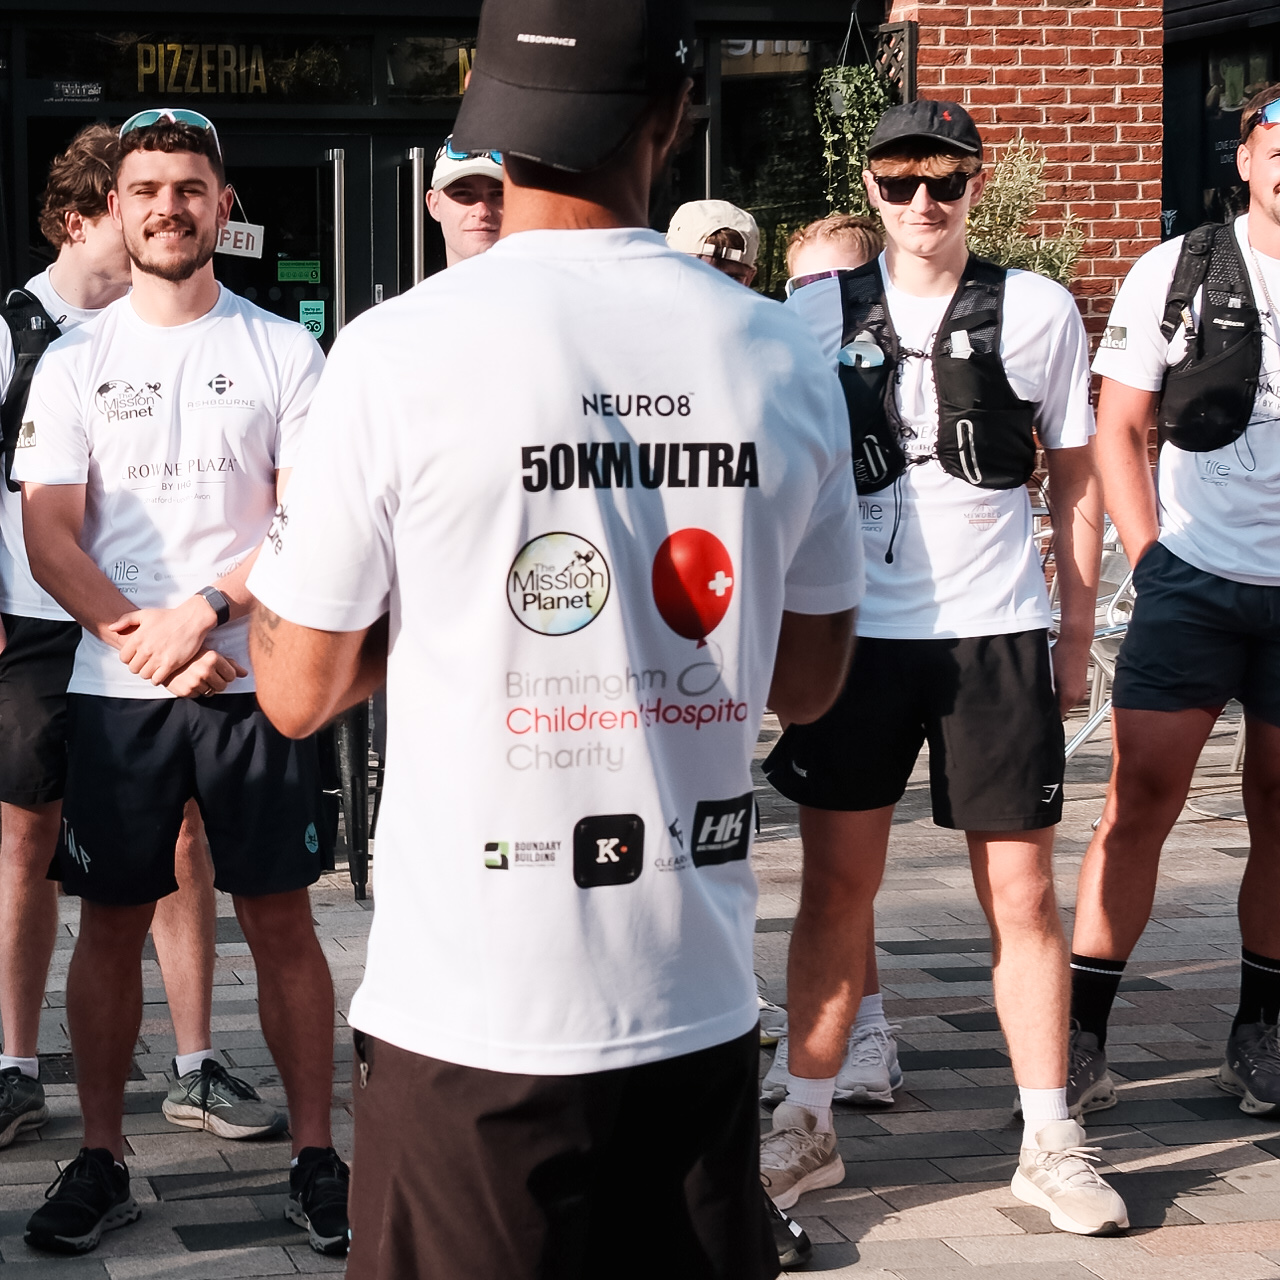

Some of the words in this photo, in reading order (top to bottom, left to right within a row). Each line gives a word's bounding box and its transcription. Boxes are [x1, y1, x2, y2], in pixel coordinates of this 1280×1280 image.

[137, 43, 268, 94] PIZZERIA
[103, 396, 155, 412] Mission
[187, 399, 256, 408] ASHBOURNE
[107, 406, 154, 423] Planet
[122, 462, 182, 480] ROWNE
[188, 458, 235, 473] PLAZA
[521, 442, 634, 493] 50KM
[638, 442, 760, 490] ULTRA
[162, 483, 174, 491] BY
[177, 480, 192, 491] IHG
[534, 563, 556, 573] The
[513, 569, 604, 593] Mission
[523, 591, 592, 612] Planet
[506, 666, 667, 701] Birminghm
[506, 742, 624, 772] Charity
[698, 809, 747, 843] HK
[515, 841, 562, 852] BOUNDARY
[515, 852, 556, 862] BUILDING
